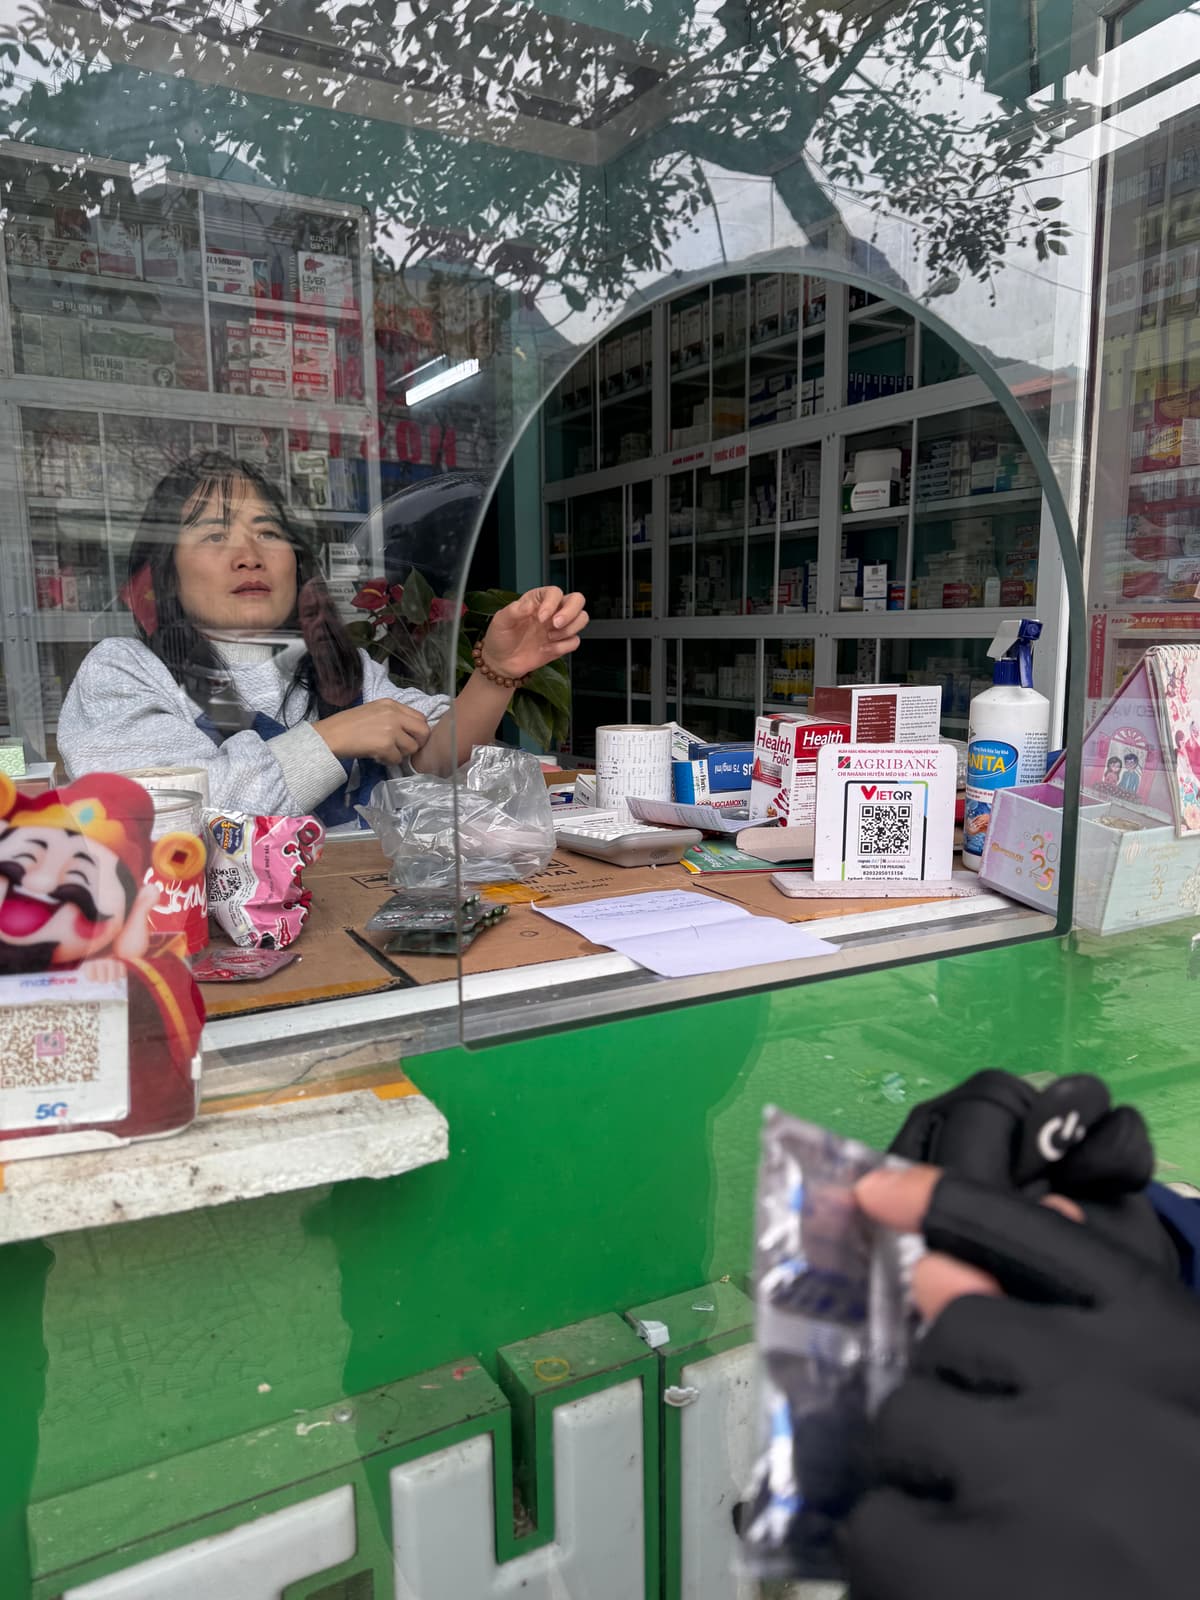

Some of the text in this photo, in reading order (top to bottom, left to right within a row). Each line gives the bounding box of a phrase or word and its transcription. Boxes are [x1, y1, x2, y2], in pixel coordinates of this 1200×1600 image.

[757, 730, 792, 754] Health
[802, 730, 844, 746] Health
[772, 751, 790, 766] Folic
[854, 758, 938, 770] AGRIBANK
[967, 752, 1007, 773] ANITA
[34, 1101, 69, 1120] 5G
